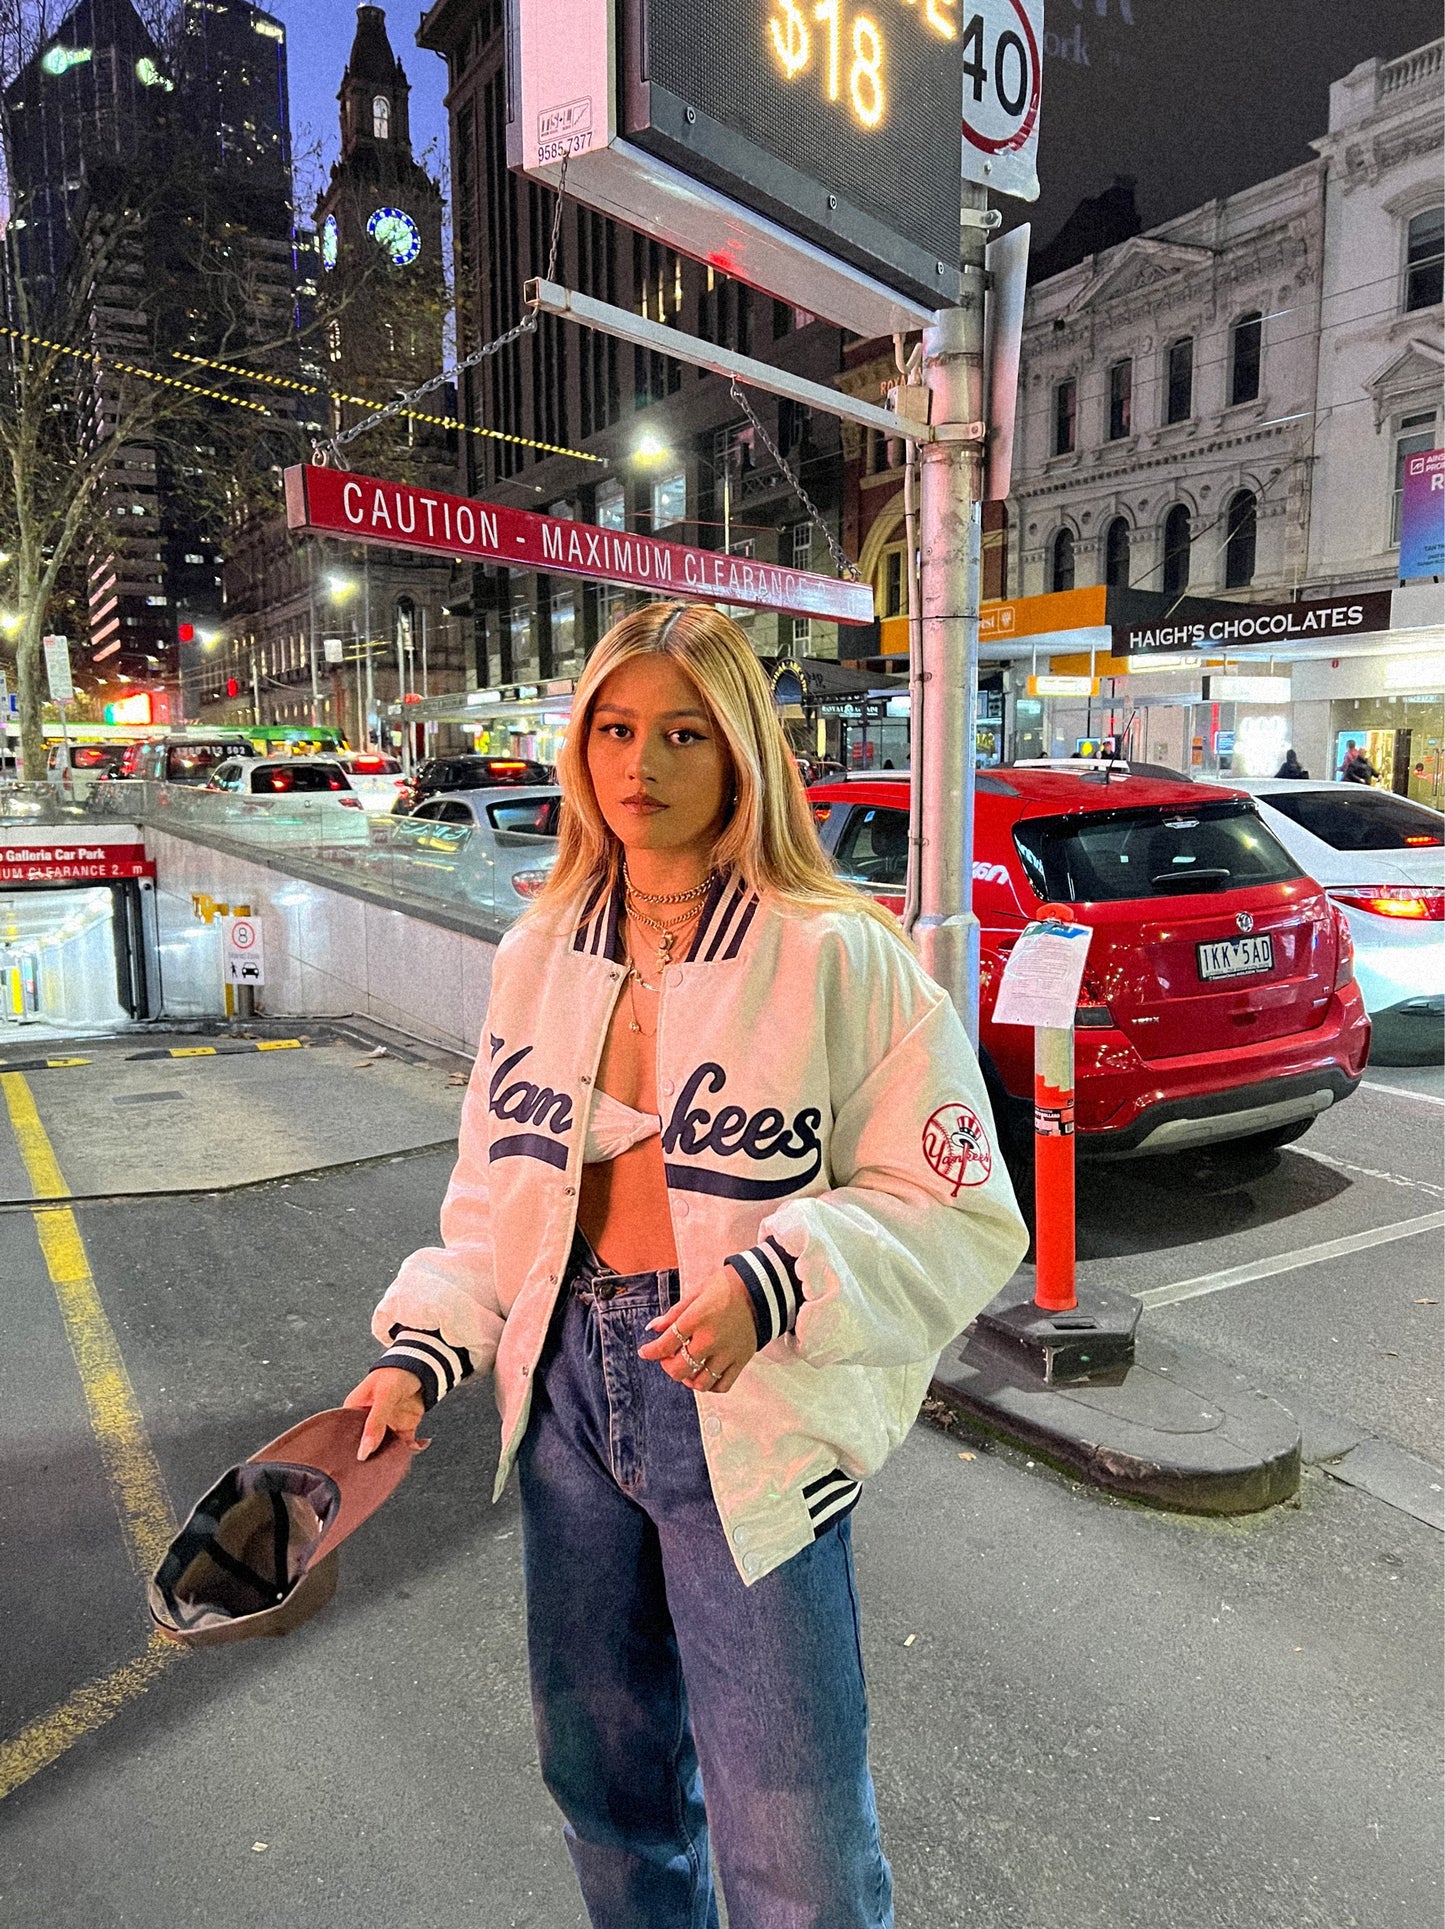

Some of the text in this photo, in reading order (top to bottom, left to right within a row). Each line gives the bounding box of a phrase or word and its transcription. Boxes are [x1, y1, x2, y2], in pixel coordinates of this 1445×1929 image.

[963, 14, 1028, 117] 40
[538, 132, 593, 162] 9585 7377
[880, 374, 906, 395] ROYA
[343, 482, 499, 549] CAUTION
[541, 523, 672, 582] MAXIMUM
[1129, 605, 1364, 649] HAIGH'S CHOCOLATES
[6, 849, 52, 861] Galleria
[55, 849, 76, 860] Car
[79, 848, 105, 860] Park
[28, 865, 106, 879] CLEARANCE
[132, 865, 143, 875] m
[238, 927, 248, 943] 8
